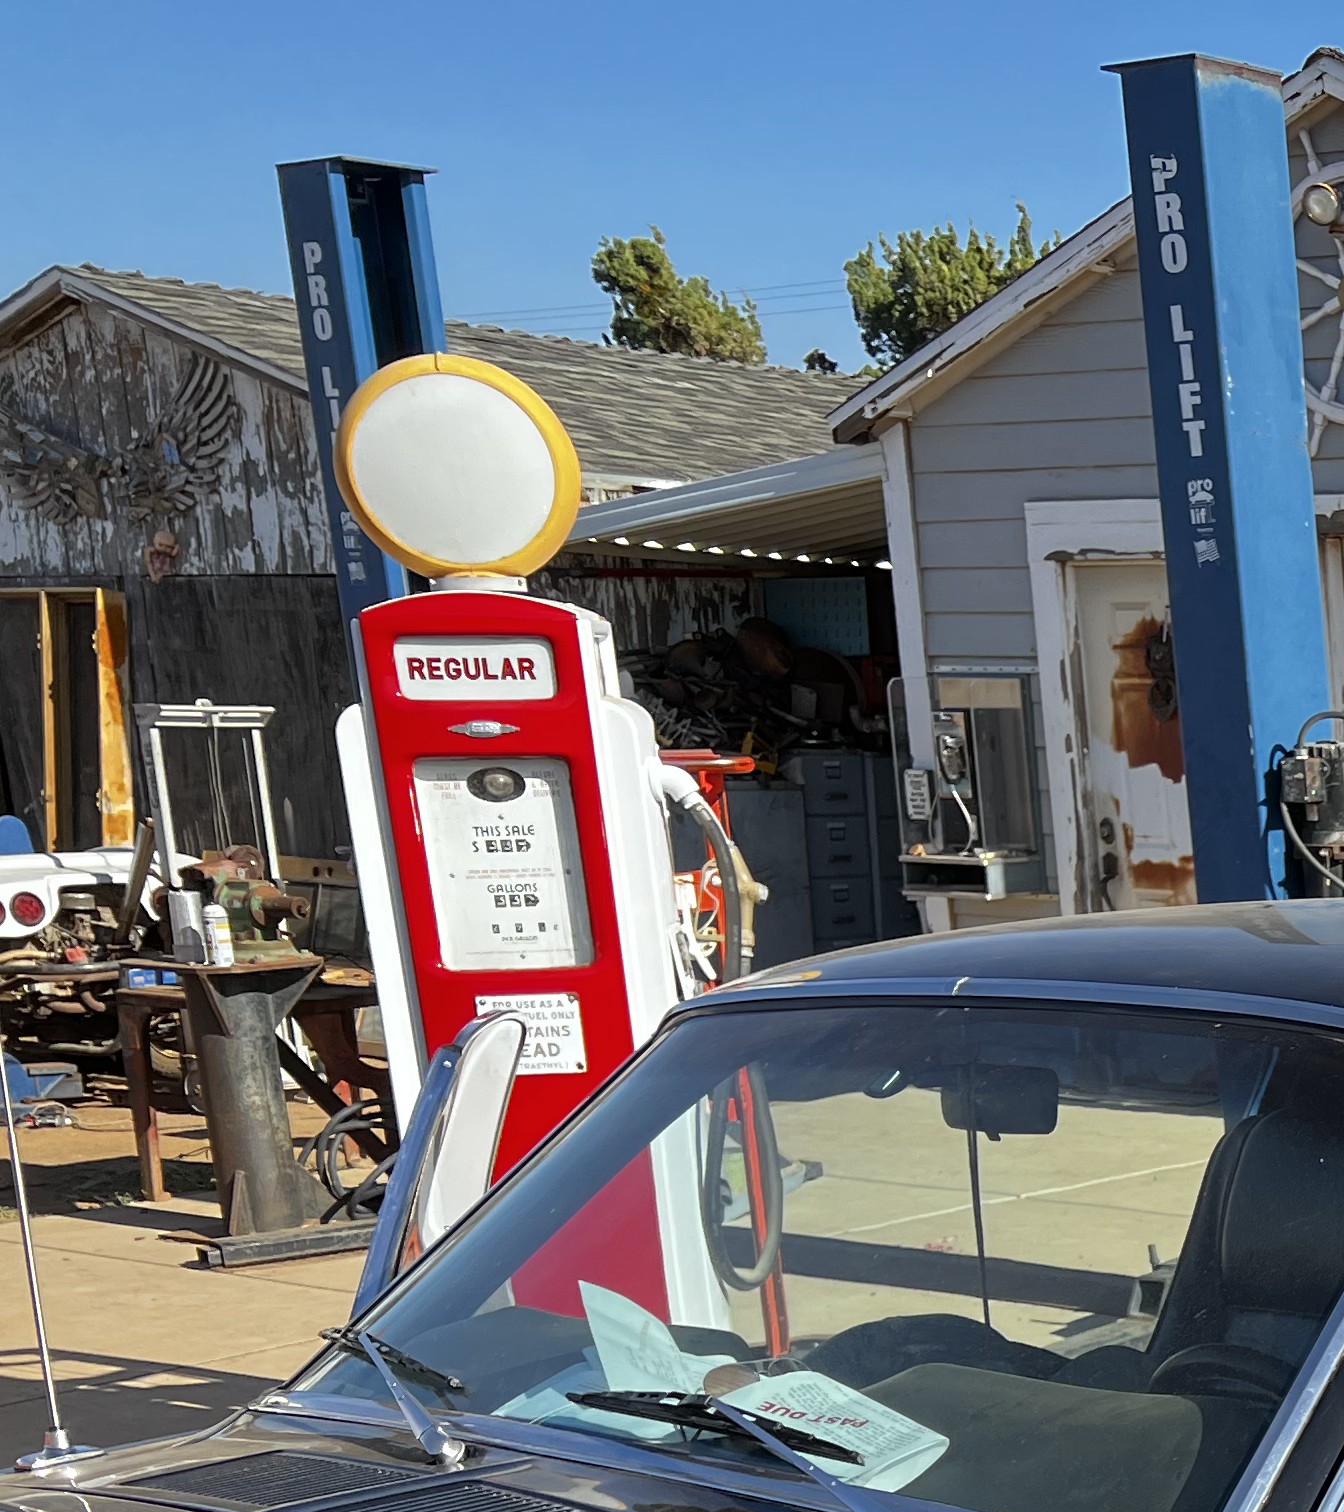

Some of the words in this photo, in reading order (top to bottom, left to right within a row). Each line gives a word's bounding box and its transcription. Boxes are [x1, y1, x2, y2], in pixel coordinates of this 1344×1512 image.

[303, 242, 333, 341] PRO
[1149, 154, 1188, 273] PRO
[1169, 305, 1206, 457] LIFT
[1187, 478, 1213, 497] pro
[406, 657, 537, 681] REGULAR
[472, 826, 500, 837] THIS
[505, 825, 535, 836] SALE
[487, 883, 538, 893] GALLONS
[516, 1001, 536, 1009] USE
[556, 1000, 564, 1008] A
[551, 1011, 575, 1020] ONLY
[526, 1026, 571, 1038] TAINS
[521, 1043, 561, 1058] EAD
[756, 1401, 807, 1419] DUE
[806, 1415, 870, 1428] PAST
